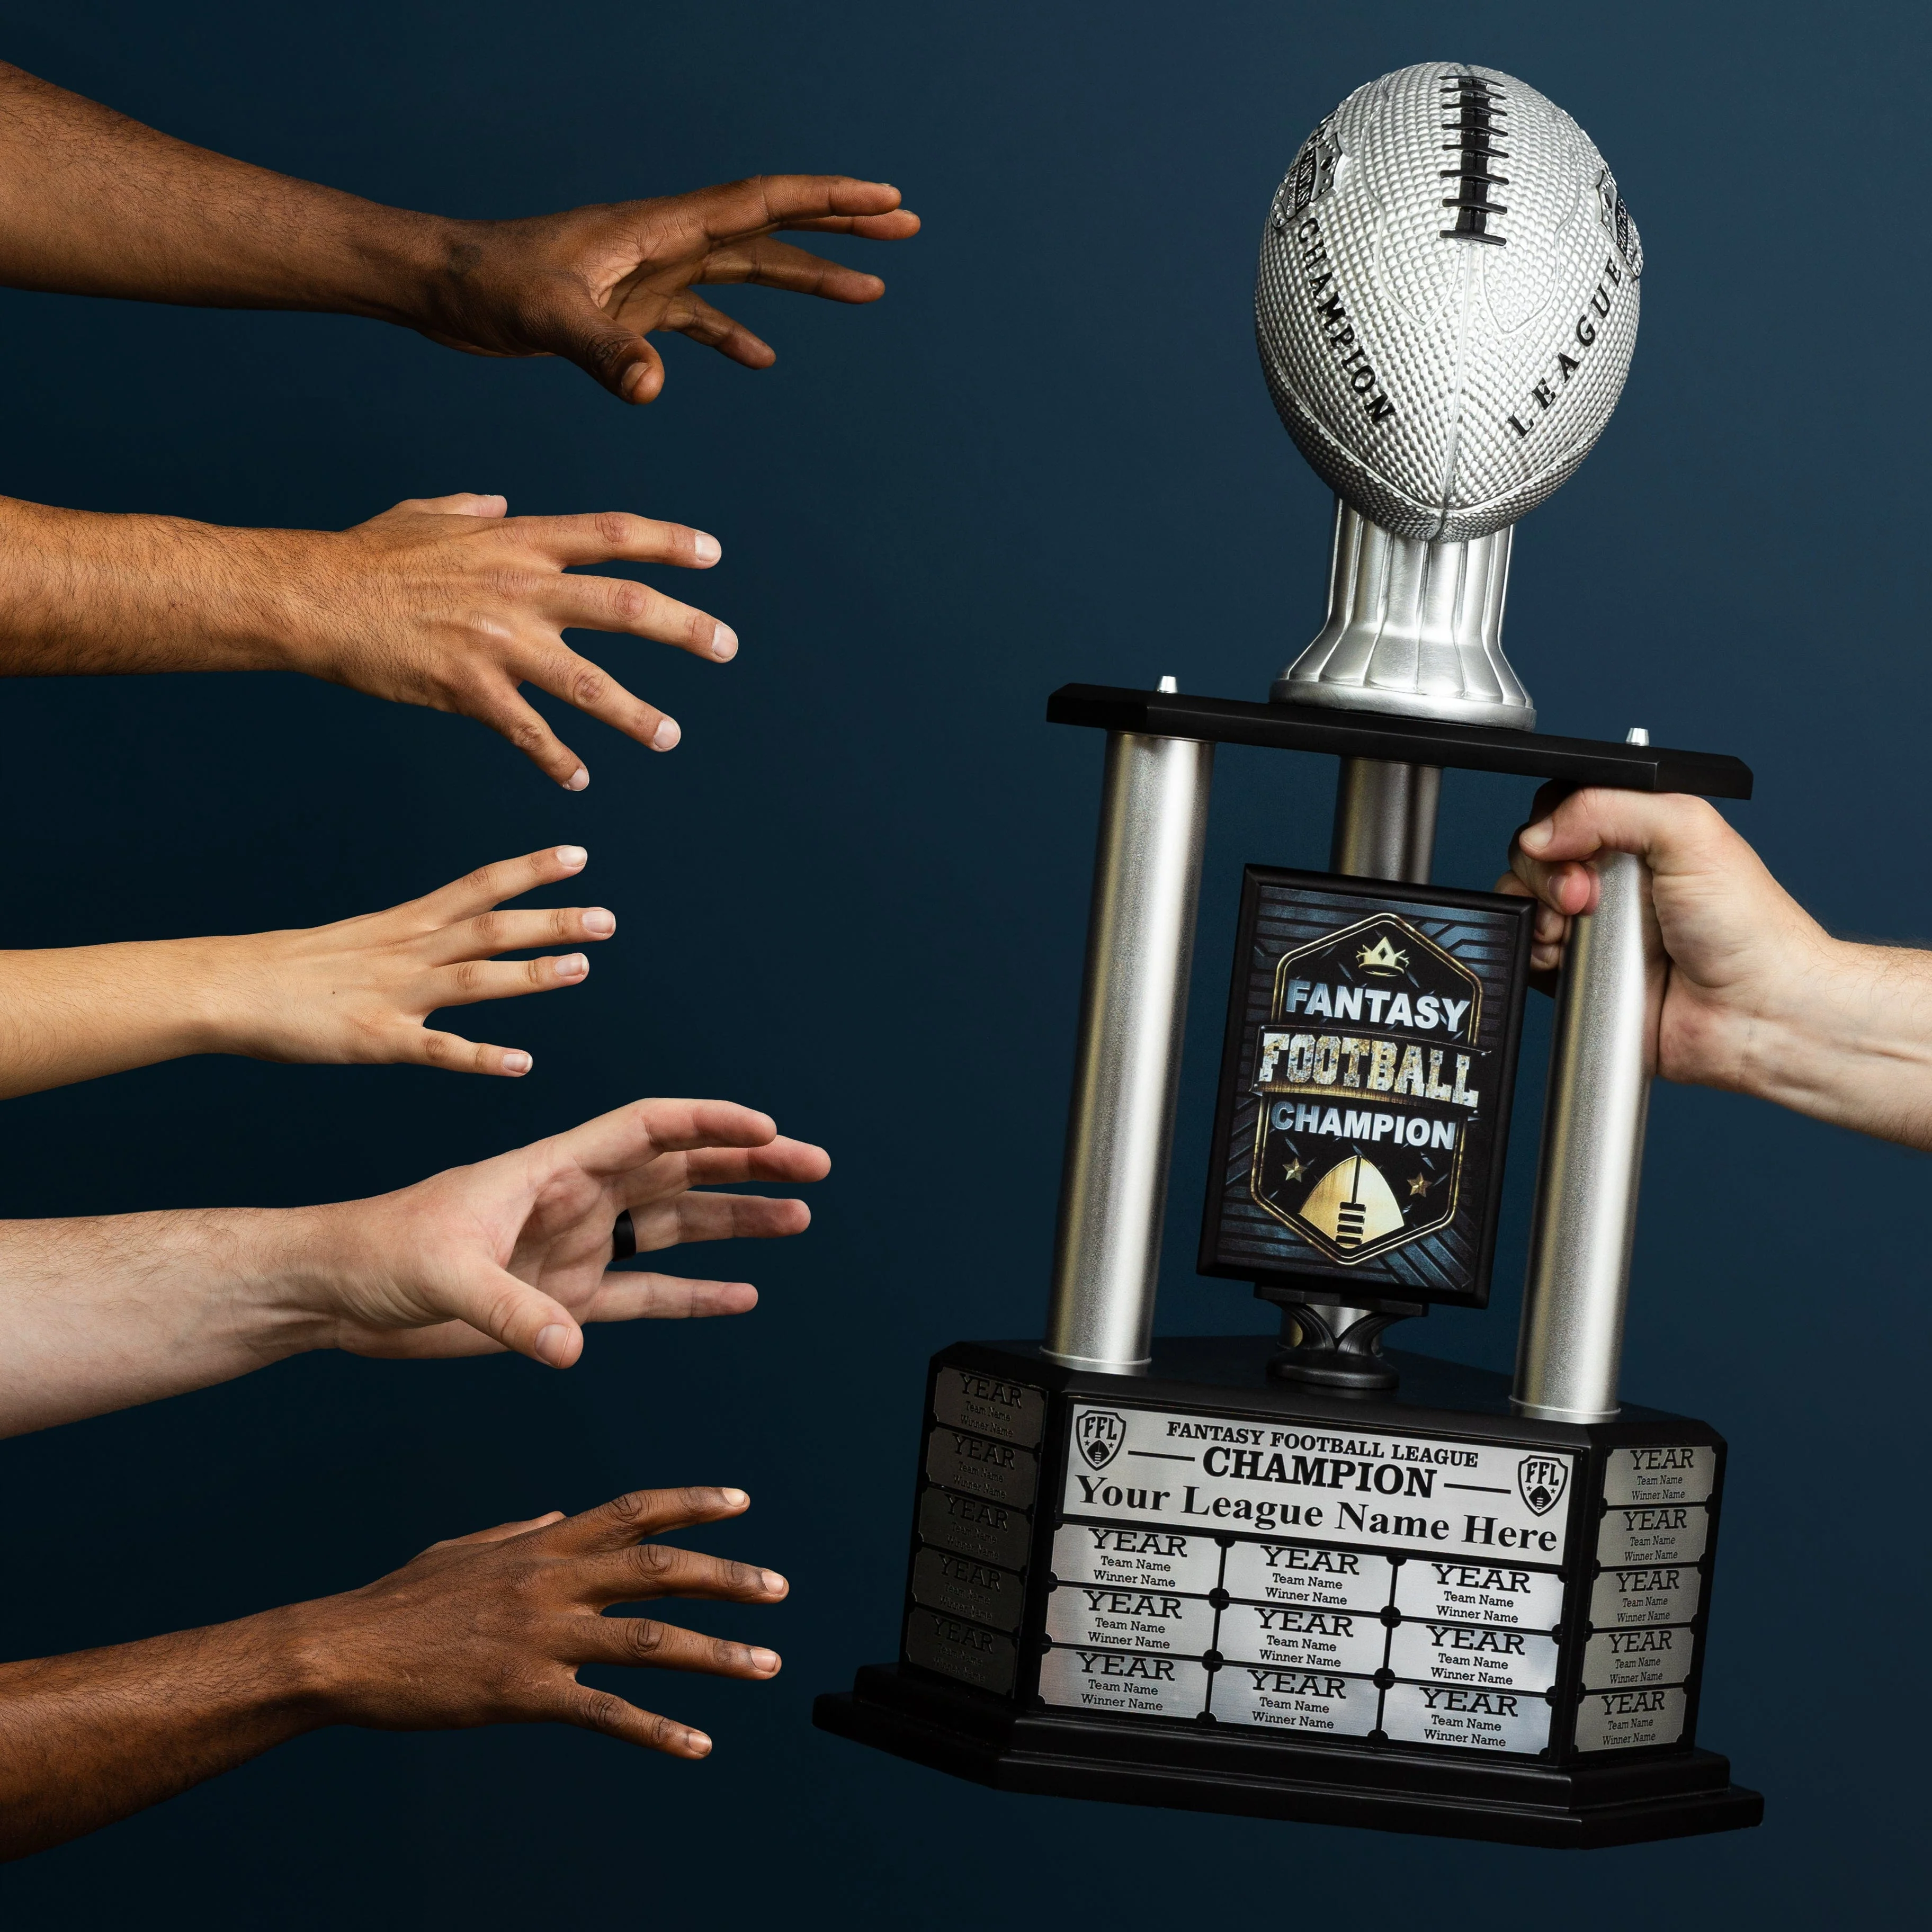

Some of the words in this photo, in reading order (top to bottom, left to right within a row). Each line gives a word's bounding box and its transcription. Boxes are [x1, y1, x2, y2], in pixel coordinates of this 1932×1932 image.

[1298, 217, 1397, 422] CHAMPION
[1507, 256, 1622, 437] LEAGUE
[1286, 979, 1470, 1031] FANTASY
[1259, 1033, 1479, 1108] FOOTBALL
[1271, 1101, 1456, 1149] CHAMPION
[960, 1373, 1022, 1409] YEAR
[966, 1401, 987, 1415] Team
[989, 1407, 1011, 1422] Name
[961, 1414, 988, 1431] Winner
[990, 1423, 1013, 1437] Name
[1083, 1416, 1117, 1440] FFL
[952, 1432, 1015, 1470] YEAR
[1167, 1421, 1265, 1445] FANTASY
[1270, 1432, 1384, 1458] FOOTBALL
[1391, 1444, 1478, 1468] LEAGUE
[1630, 1448, 1694, 1470] YEAR
[959, 1461, 979, 1474] Team
[981, 1468, 1004, 1482] Name
[1203, 1446, 1437, 1498] CHAMPION
[1525, 1462, 1559, 1486] FFL
[1637, 1475, 1658, 1485] Team
[1660, 1475, 1683, 1484] Name
[953, 1474, 981, 1491] Winner
[983, 1483, 1006, 1499] Name
[1632, 1490, 1661, 1500] Winner
[1662, 1489, 1685, 1499] Name
[945, 1494, 1008, 1532] YEAR
[1075, 1475, 1170, 1510] Your
[1180, 1486, 1322, 1530] League
[1335, 1502, 1449, 1540] Name
[1461, 1515, 1557, 1551] Here
[1623, 1509, 1687, 1531] YEAR
[952, 1522, 972, 1535] Team
[975, 1528, 997, 1544] Name
[1088, 1528, 1187, 1557] YEAR
[1630, 1536, 1650, 1546] Team
[1652, 1535, 1676, 1545] Name
[947, 1535, 974, 1551] Winner
[978, 1544, 999, 1560] Name
[1624, 1551, 1653, 1561] Winner
[1654, 1550, 1678, 1560] Name
[1101, 1555, 1133, 1568] Team
[1136, 1559, 1170, 1571] Name
[1260, 1545, 1359, 1575] YEAR
[938, 1554, 1000, 1593] YEAR
[1094, 1570, 1138, 1584] Winner
[1140, 1575, 1175, 1587] Name
[1273, 1573, 1304, 1585] Team
[1308, 1577, 1343, 1589] Name
[1432, 1563, 1531, 1593] YEAR
[1616, 1570, 1679, 1593] YEAR
[945, 1582, 965, 1596] Team
[968, 1589, 990, 1605] Name
[1083, 1590, 1182, 1619] YEAR
[1265, 1587, 1310, 1601] Winner
[1312, 1592, 1347, 1605] Name
[1444, 1591, 1475, 1604] Team
[1479, 1595, 1514, 1607] Name
[1623, 1598, 1643, 1607] Team
[1645, 1597, 1668, 1606] Name
[940, 1595, 967, 1612] Winner
[970, 1605, 992, 1621] Name
[1436, 1605, 1481, 1619] Winner
[1483, 1610, 1518, 1623] Name
[1617, 1613, 1646, 1622] Winner
[1648, 1611, 1670, 1621] Name
[1095, 1617, 1127, 1630] Team
[1130, 1621, 1165, 1633] Name
[1254, 1607, 1353, 1637] YEAR
[931, 1615, 993, 1654] YEAR
[1088, 1631, 1132, 1645] Winner
[1135, 1636, 1170, 1649] Name
[1267, 1635, 1298, 1648] Team
[1302, 1639, 1336, 1651] Name
[1426, 1625, 1525, 1655] YEAR
[1608, 1630, 1672, 1653] YEAR
[1076, 1652, 1175, 1681] YEAR
[1259, 1649, 1303, 1663] Winner
[1306, 1654, 1341, 1667] Name
[1438, 1653, 1470, 1666] Team
[1473, 1657, 1508, 1669] Name
[1615, 1659, 1636, 1669] Team
[1638, 1657, 1661, 1667] Name
[1088, 1679, 1120, 1692] Team
[1123, 1683, 1158, 1695] Name
[1247, 1669, 1346, 1699] YEAR
[1431, 1667, 1475, 1681] Winner
[1478, 1672, 1513, 1685] Name
[1610, 1674, 1639, 1684] Winner
[1640, 1671, 1663, 1681] Name
[1080, 1694, 1125, 1707] Winner
[1128, 1698, 1163, 1711] Name
[1259, 1697, 1291, 1709] Team
[1294, 1701, 1329, 1713] Name
[1419, 1687, 1518, 1717] YEAR
[1602, 1691, 1665, 1715] YEAR
[1252, 1711, 1296, 1725] Winner
[1299, 1716, 1334, 1729] Name
[1432, 1714, 1463, 1727] Team
[1466, 1718, 1501, 1731] Name
[1608, 1720, 1629, 1730] Team
[1631, 1718, 1653, 1728] Name
[1424, 1729, 1468, 1742] Winner
[1471, 1734, 1506, 1747] Name
[1603, 1736, 1632, 1745] Winner
[1633, 1732, 1656, 1742] Name
